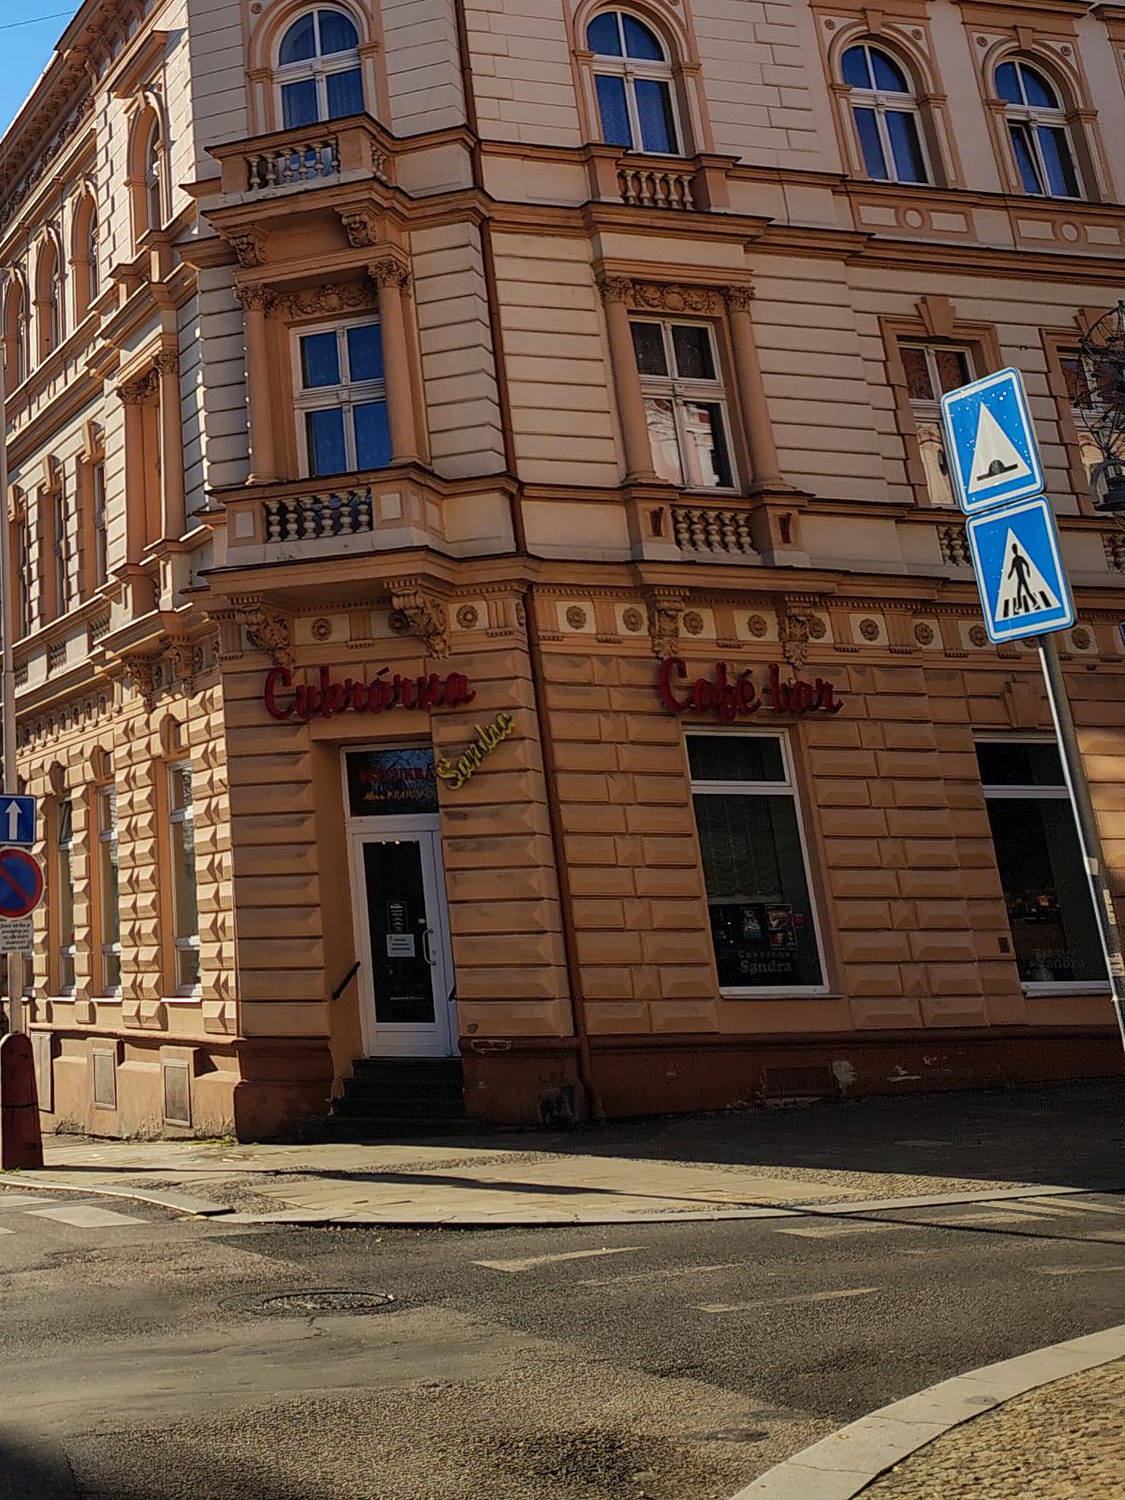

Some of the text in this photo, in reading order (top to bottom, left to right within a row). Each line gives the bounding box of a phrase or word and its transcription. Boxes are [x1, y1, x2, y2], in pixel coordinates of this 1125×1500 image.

[264, 665, 477, 721] Cukrárna
[659, 657, 845, 723] Café bar
[436, 711, 516, 790] Sandra
